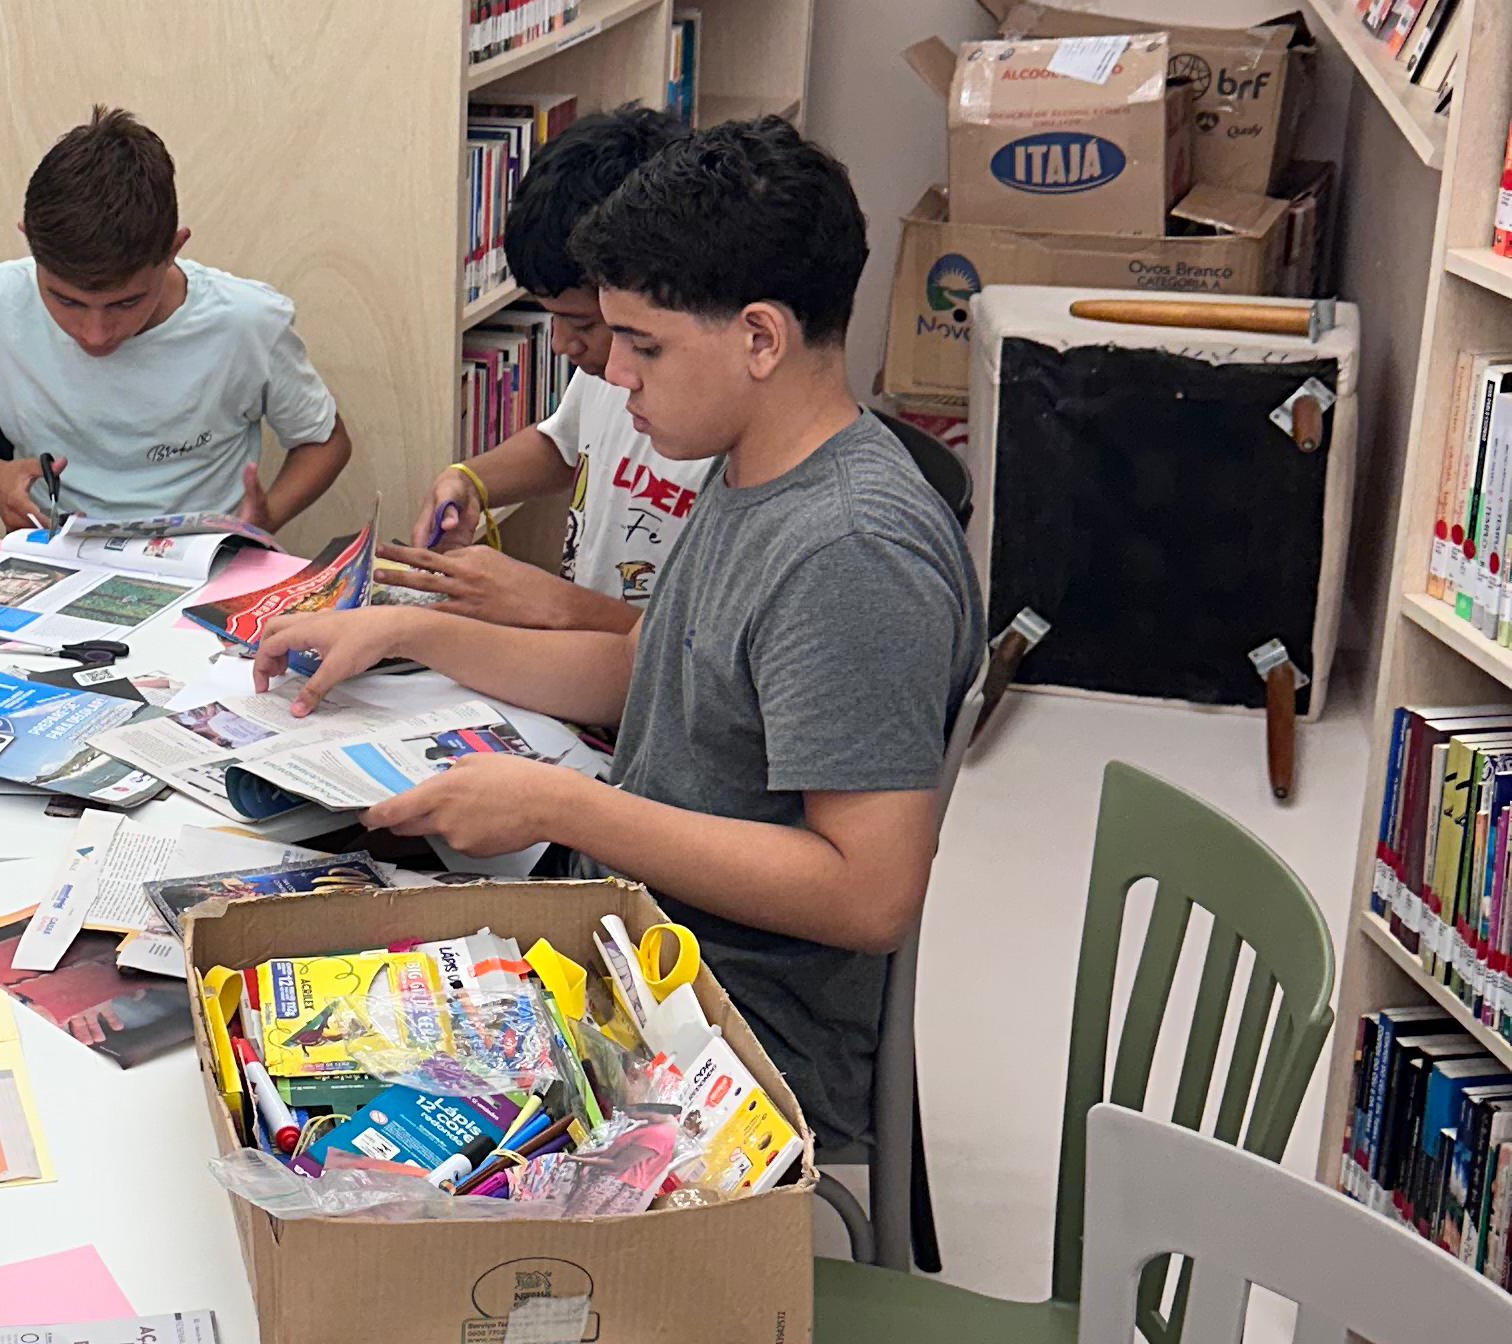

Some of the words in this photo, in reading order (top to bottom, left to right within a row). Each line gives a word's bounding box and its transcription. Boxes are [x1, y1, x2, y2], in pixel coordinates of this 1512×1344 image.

[1217, 67, 1271, 100] brf
[1014, 136, 1102, 184] ITAJÁ
[1128, 260, 1171, 276] Ovos
[1176, 262, 1233, 278] Branco
[301, 978, 314, 1010] ACRILEX
[416, 1094, 437, 1115] 12
[436, 1112, 475, 1145] core
[435, 1097, 483, 1137] Lápis
